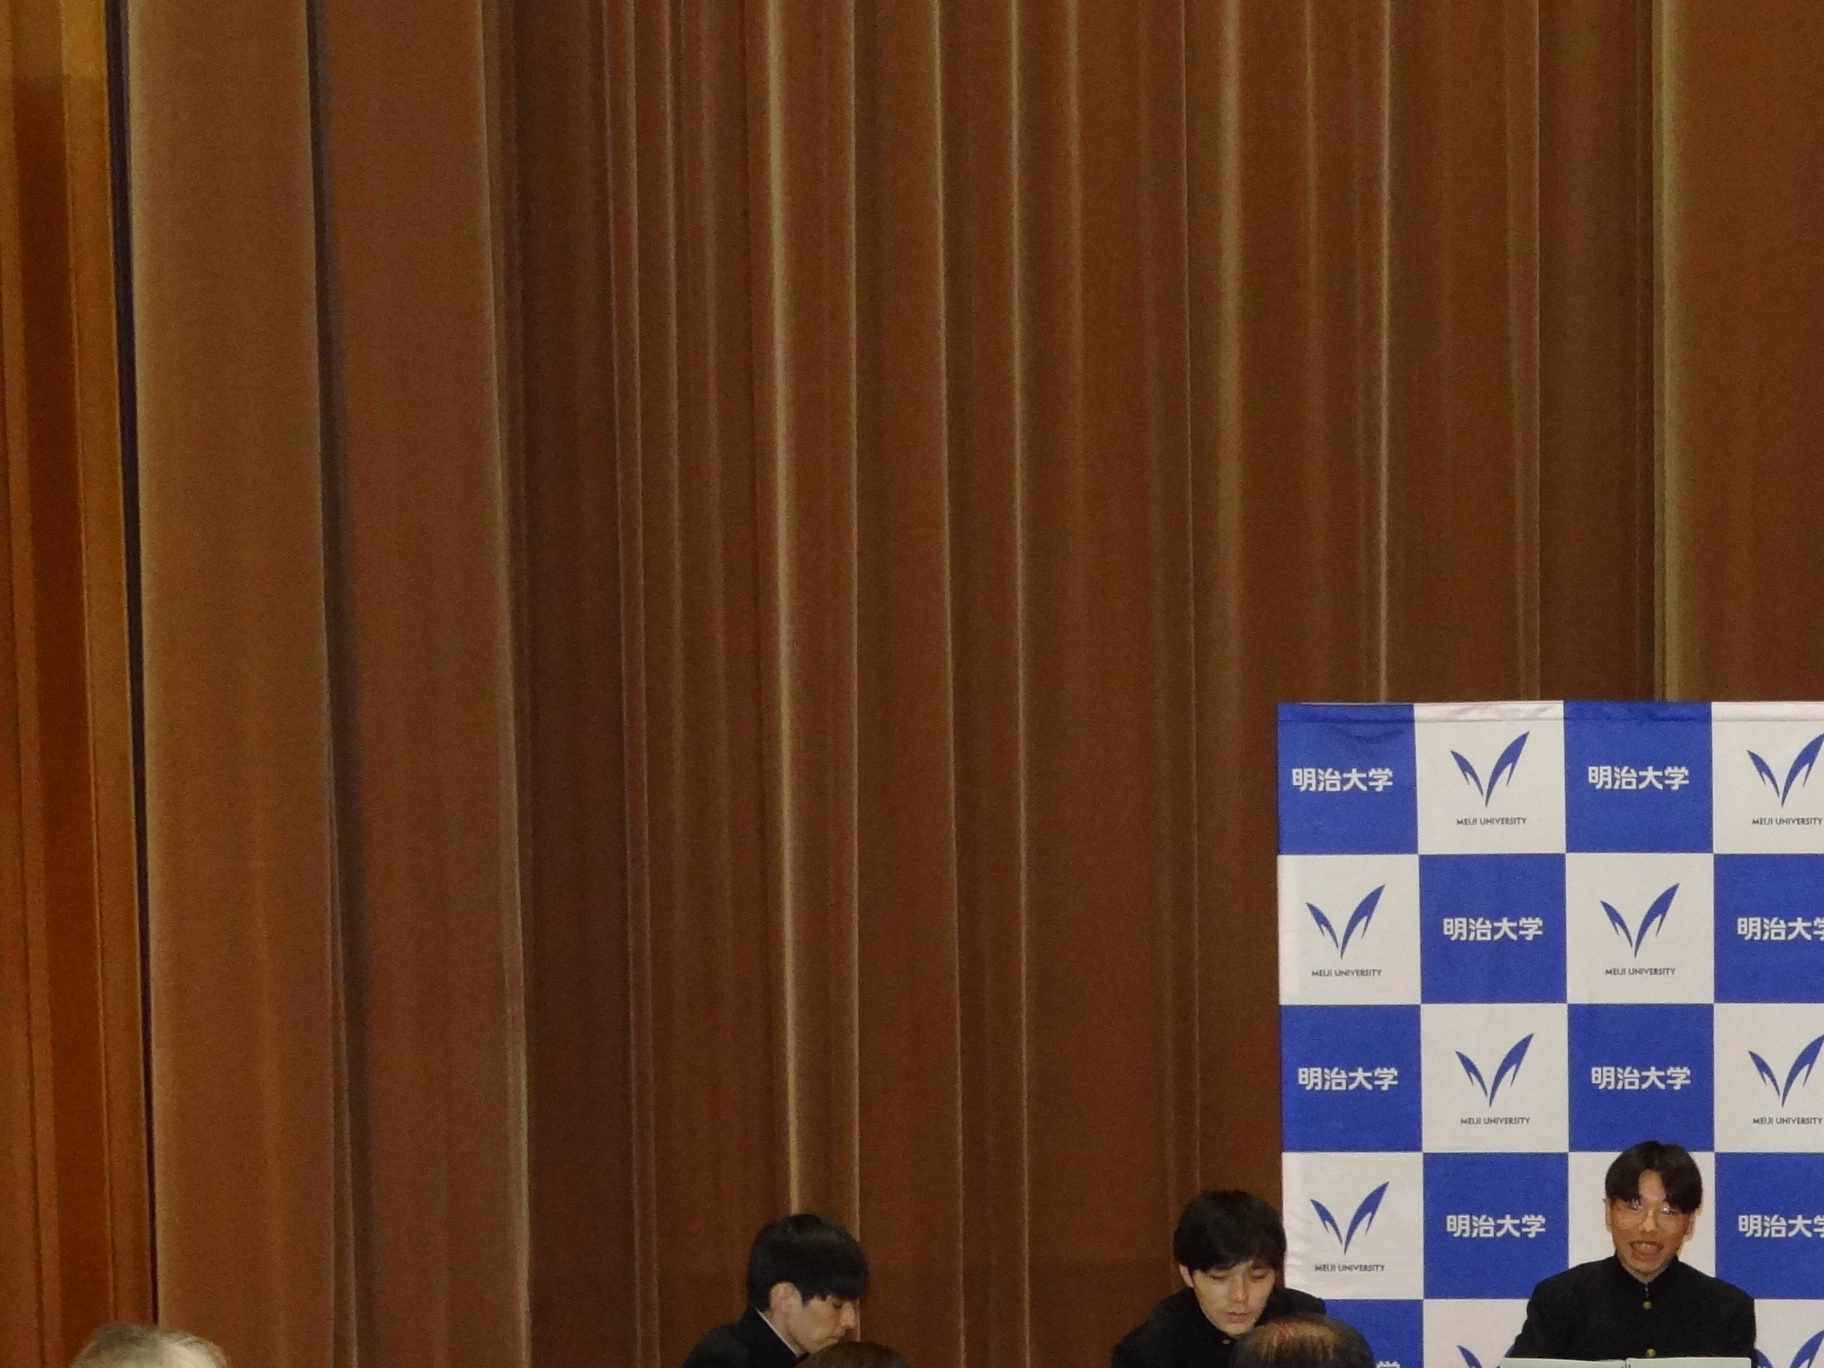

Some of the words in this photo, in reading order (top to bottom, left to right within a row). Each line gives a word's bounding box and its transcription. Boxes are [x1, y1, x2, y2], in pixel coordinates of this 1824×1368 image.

[1291, 767, 1394, 792] 明治大学
[1587, 765, 1690, 791] 明治大学
[1456, 817, 1478, 826] MEIJI
[1479, 817, 1527, 826] UNIVERSITY
[1751, 817, 1774, 826] MEIJI
[1775, 817, 1823, 826] UNIVERSITY
[1443, 916, 1544, 941] 明治大学
[1311, 968, 1333, 977] MEIJI
[1334, 968, 1382, 977] UNIVERSITY
[1604, 967, 1627, 976] MEIJI
[1628, 967, 1676, 976] UNIVERSITY
[1298, 1067, 1399, 1091] 明治大学
[1591, 1066, 1691, 1090] 明治大学
[1460, 1116, 1482, 1125] MEIJI
[1483, 1116, 1530, 1125] UNIVERSITY
[1752, 1116, 1774, 1125] MEIJI
[1775, 1116, 1823, 1125] UNIVERSITY
[1446, 1214, 1546, 1238] 明治大学
[1314, 1264, 1336, 1272] MEIJI
[1337, 1264, 1385, 1272] UNIVERSITY
